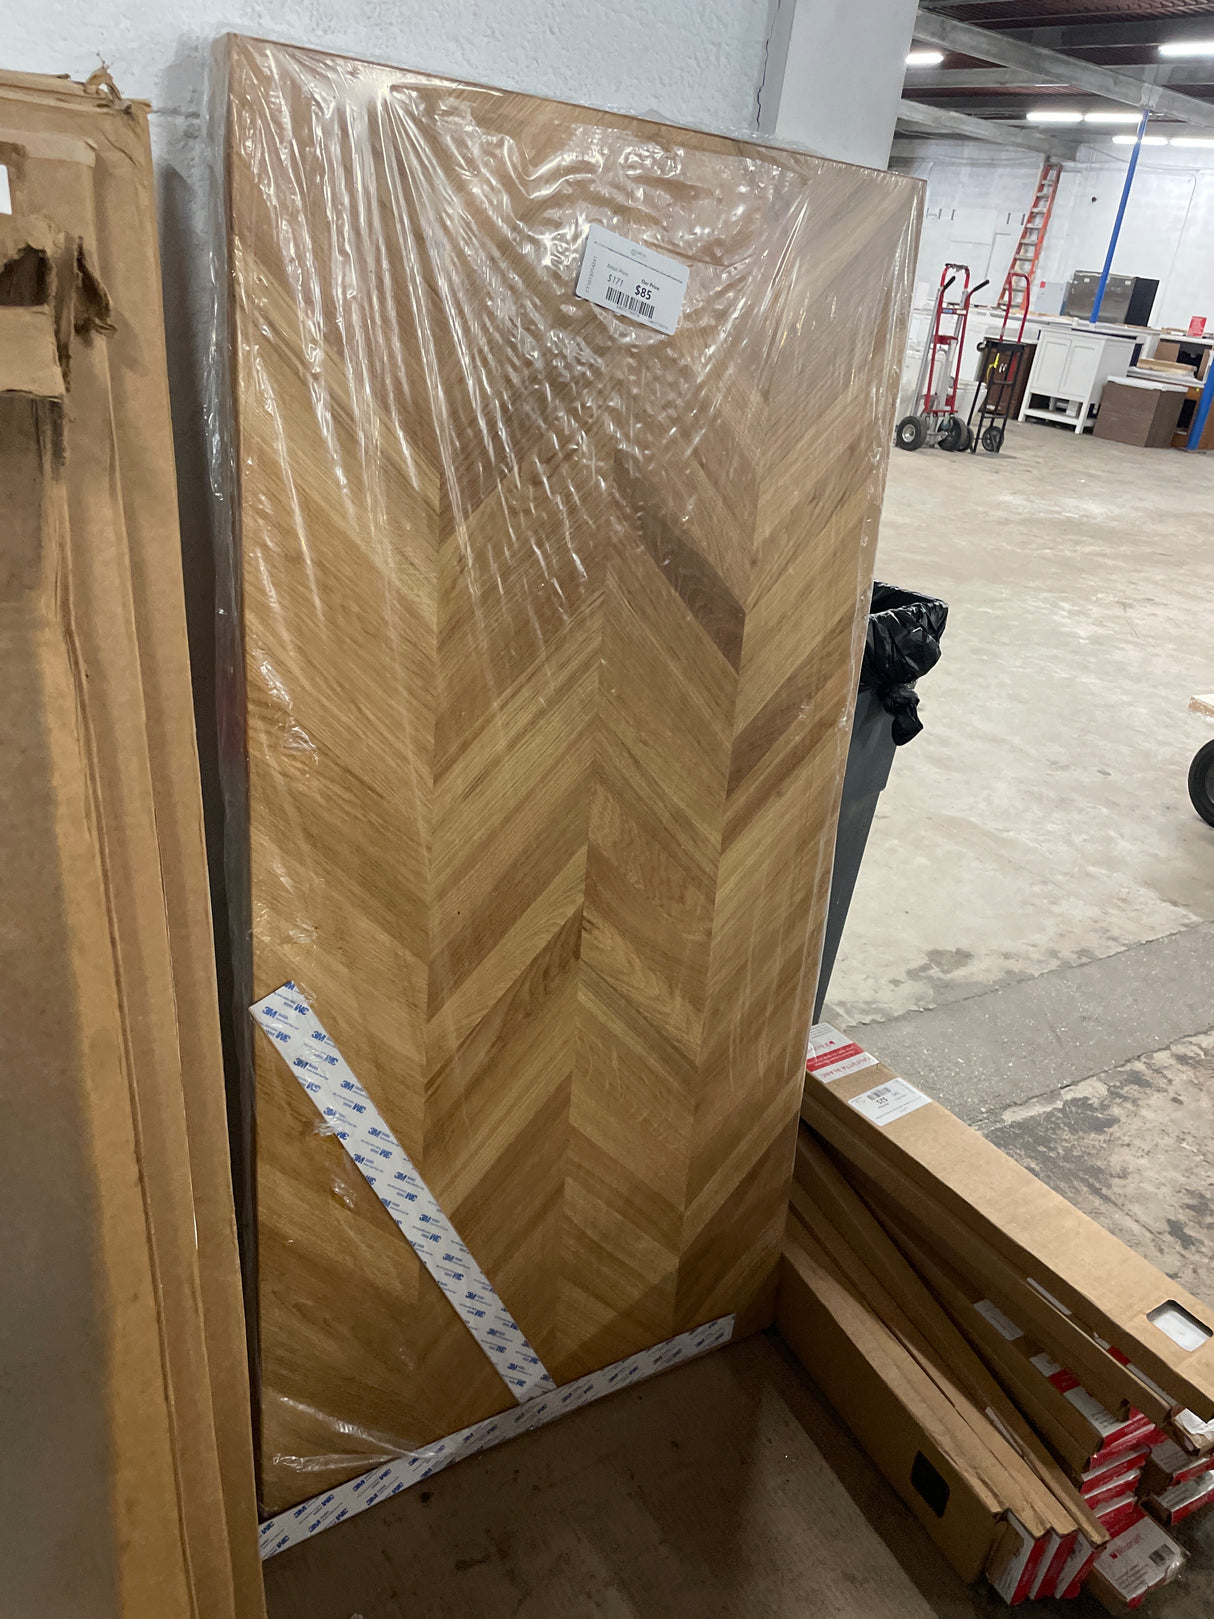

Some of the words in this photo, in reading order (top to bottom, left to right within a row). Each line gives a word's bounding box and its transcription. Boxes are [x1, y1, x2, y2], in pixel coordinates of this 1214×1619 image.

[608, 274, 624, 286] $171
[634, 285, 652, 300] $85
[262, 1006, 278, 1018] 3M
[294, 1004, 309, 1015] 3M
[276, 1031, 290, 1042] 3M
[312, 1030, 326, 1042] 3M
[293, 1058, 308, 1069] 3M
[324, 1054, 338, 1066] 3M
[340, 1080, 355, 1092] 3M
[352, 1102, 366, 1114] 3M
[368, 1127, 382, 1138] 3M
[353, 1154, 366, 1164] 3M
[379, 1148, 392, 1159] 3M
[394, 1171, 408, 1182] 3M
[404, 1192, 418, 1202] 3M
[419, 1214, 432, 1224] 3M
[429, 1233, 442, 1242] 3M
[443, 1253, 455, 1262] 3M
[452, 1272, 464, 1281] 3M
[465, 1292, 477, 1300] 3M
[352, 1480, 365, 1492] 3M
[322, 1494, 335, 1506] 3M
[366, 1493, 378, 1505] 3M
[294, 1506, 307, 1518] 3M
[336, 1508, 348, 1520] 3M
[308, 1520, 321, 1532] 3M
[276, 1535, 290, 1548] 3M
